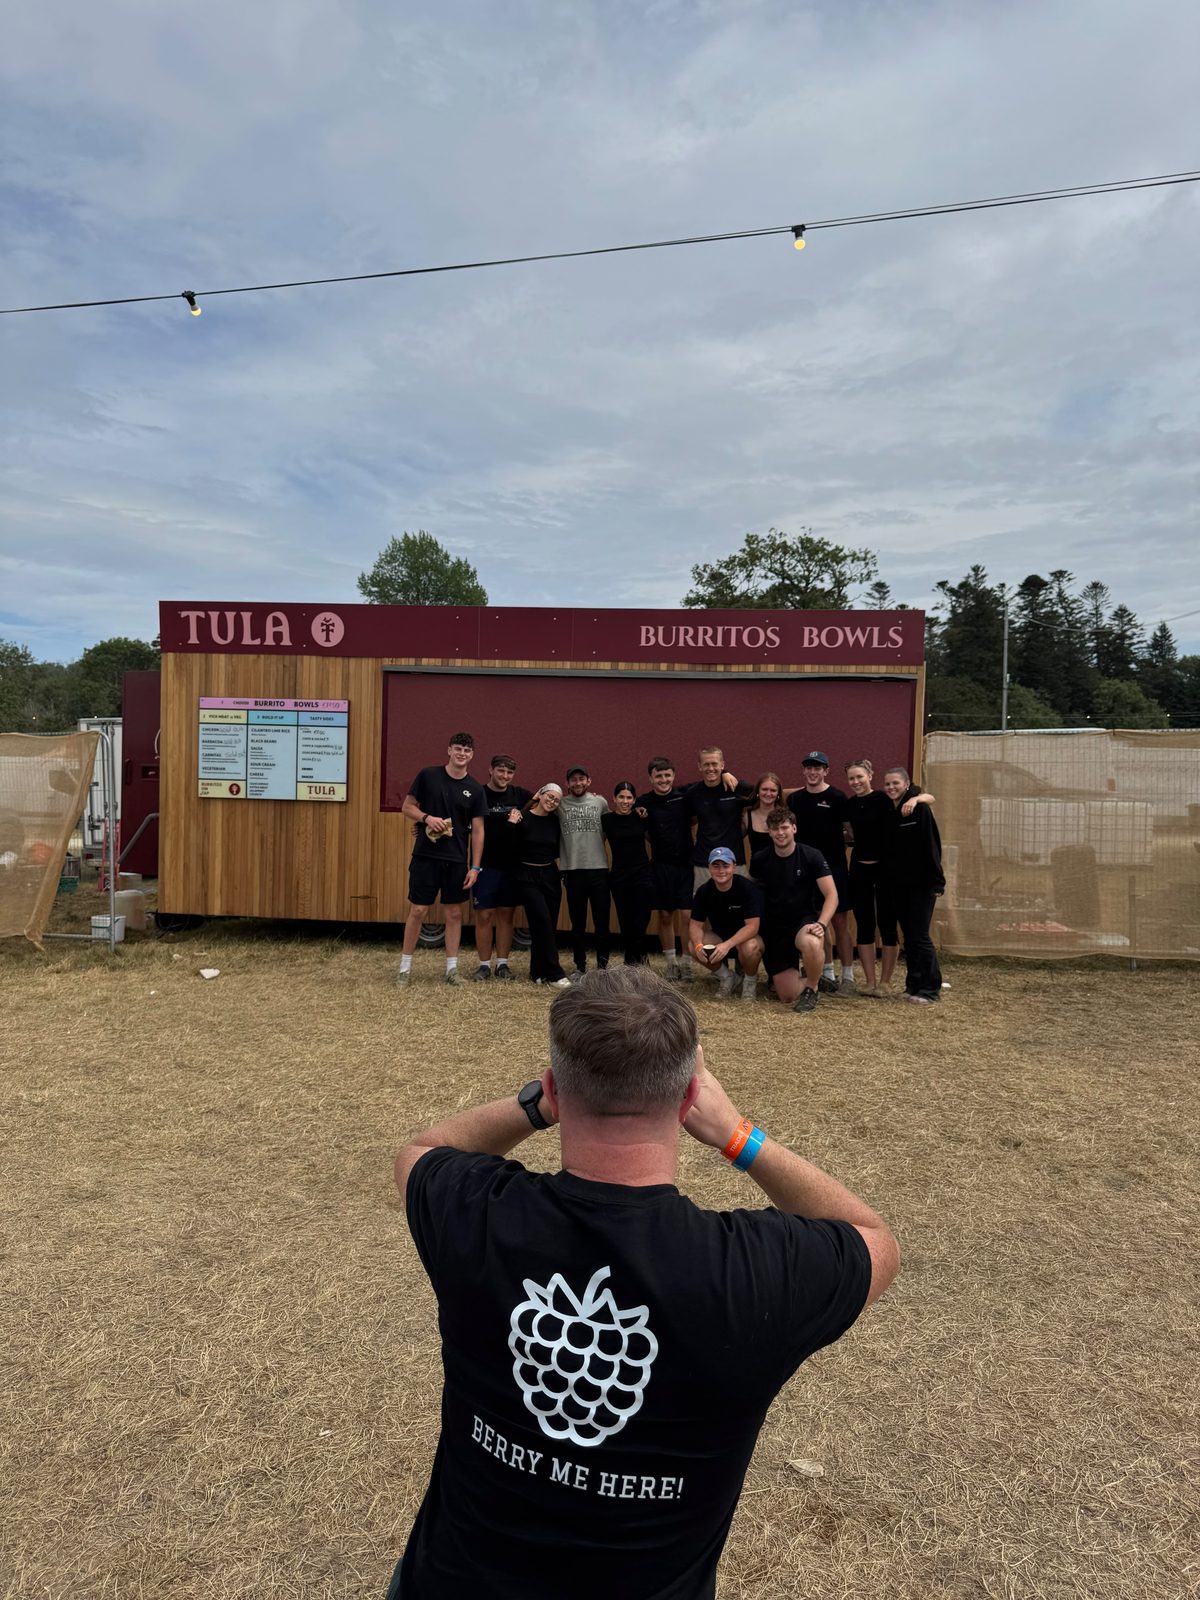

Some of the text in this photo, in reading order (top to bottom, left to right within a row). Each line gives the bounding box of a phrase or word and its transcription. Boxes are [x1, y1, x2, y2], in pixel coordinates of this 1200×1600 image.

[181, 611, 292, 646] TULA
[640, 625, 903, 649] BURRITOS BOWLS
[307, 786, 335, 795] TULA
[472, 1415, 684, 1499] BERRY ME HERE!
